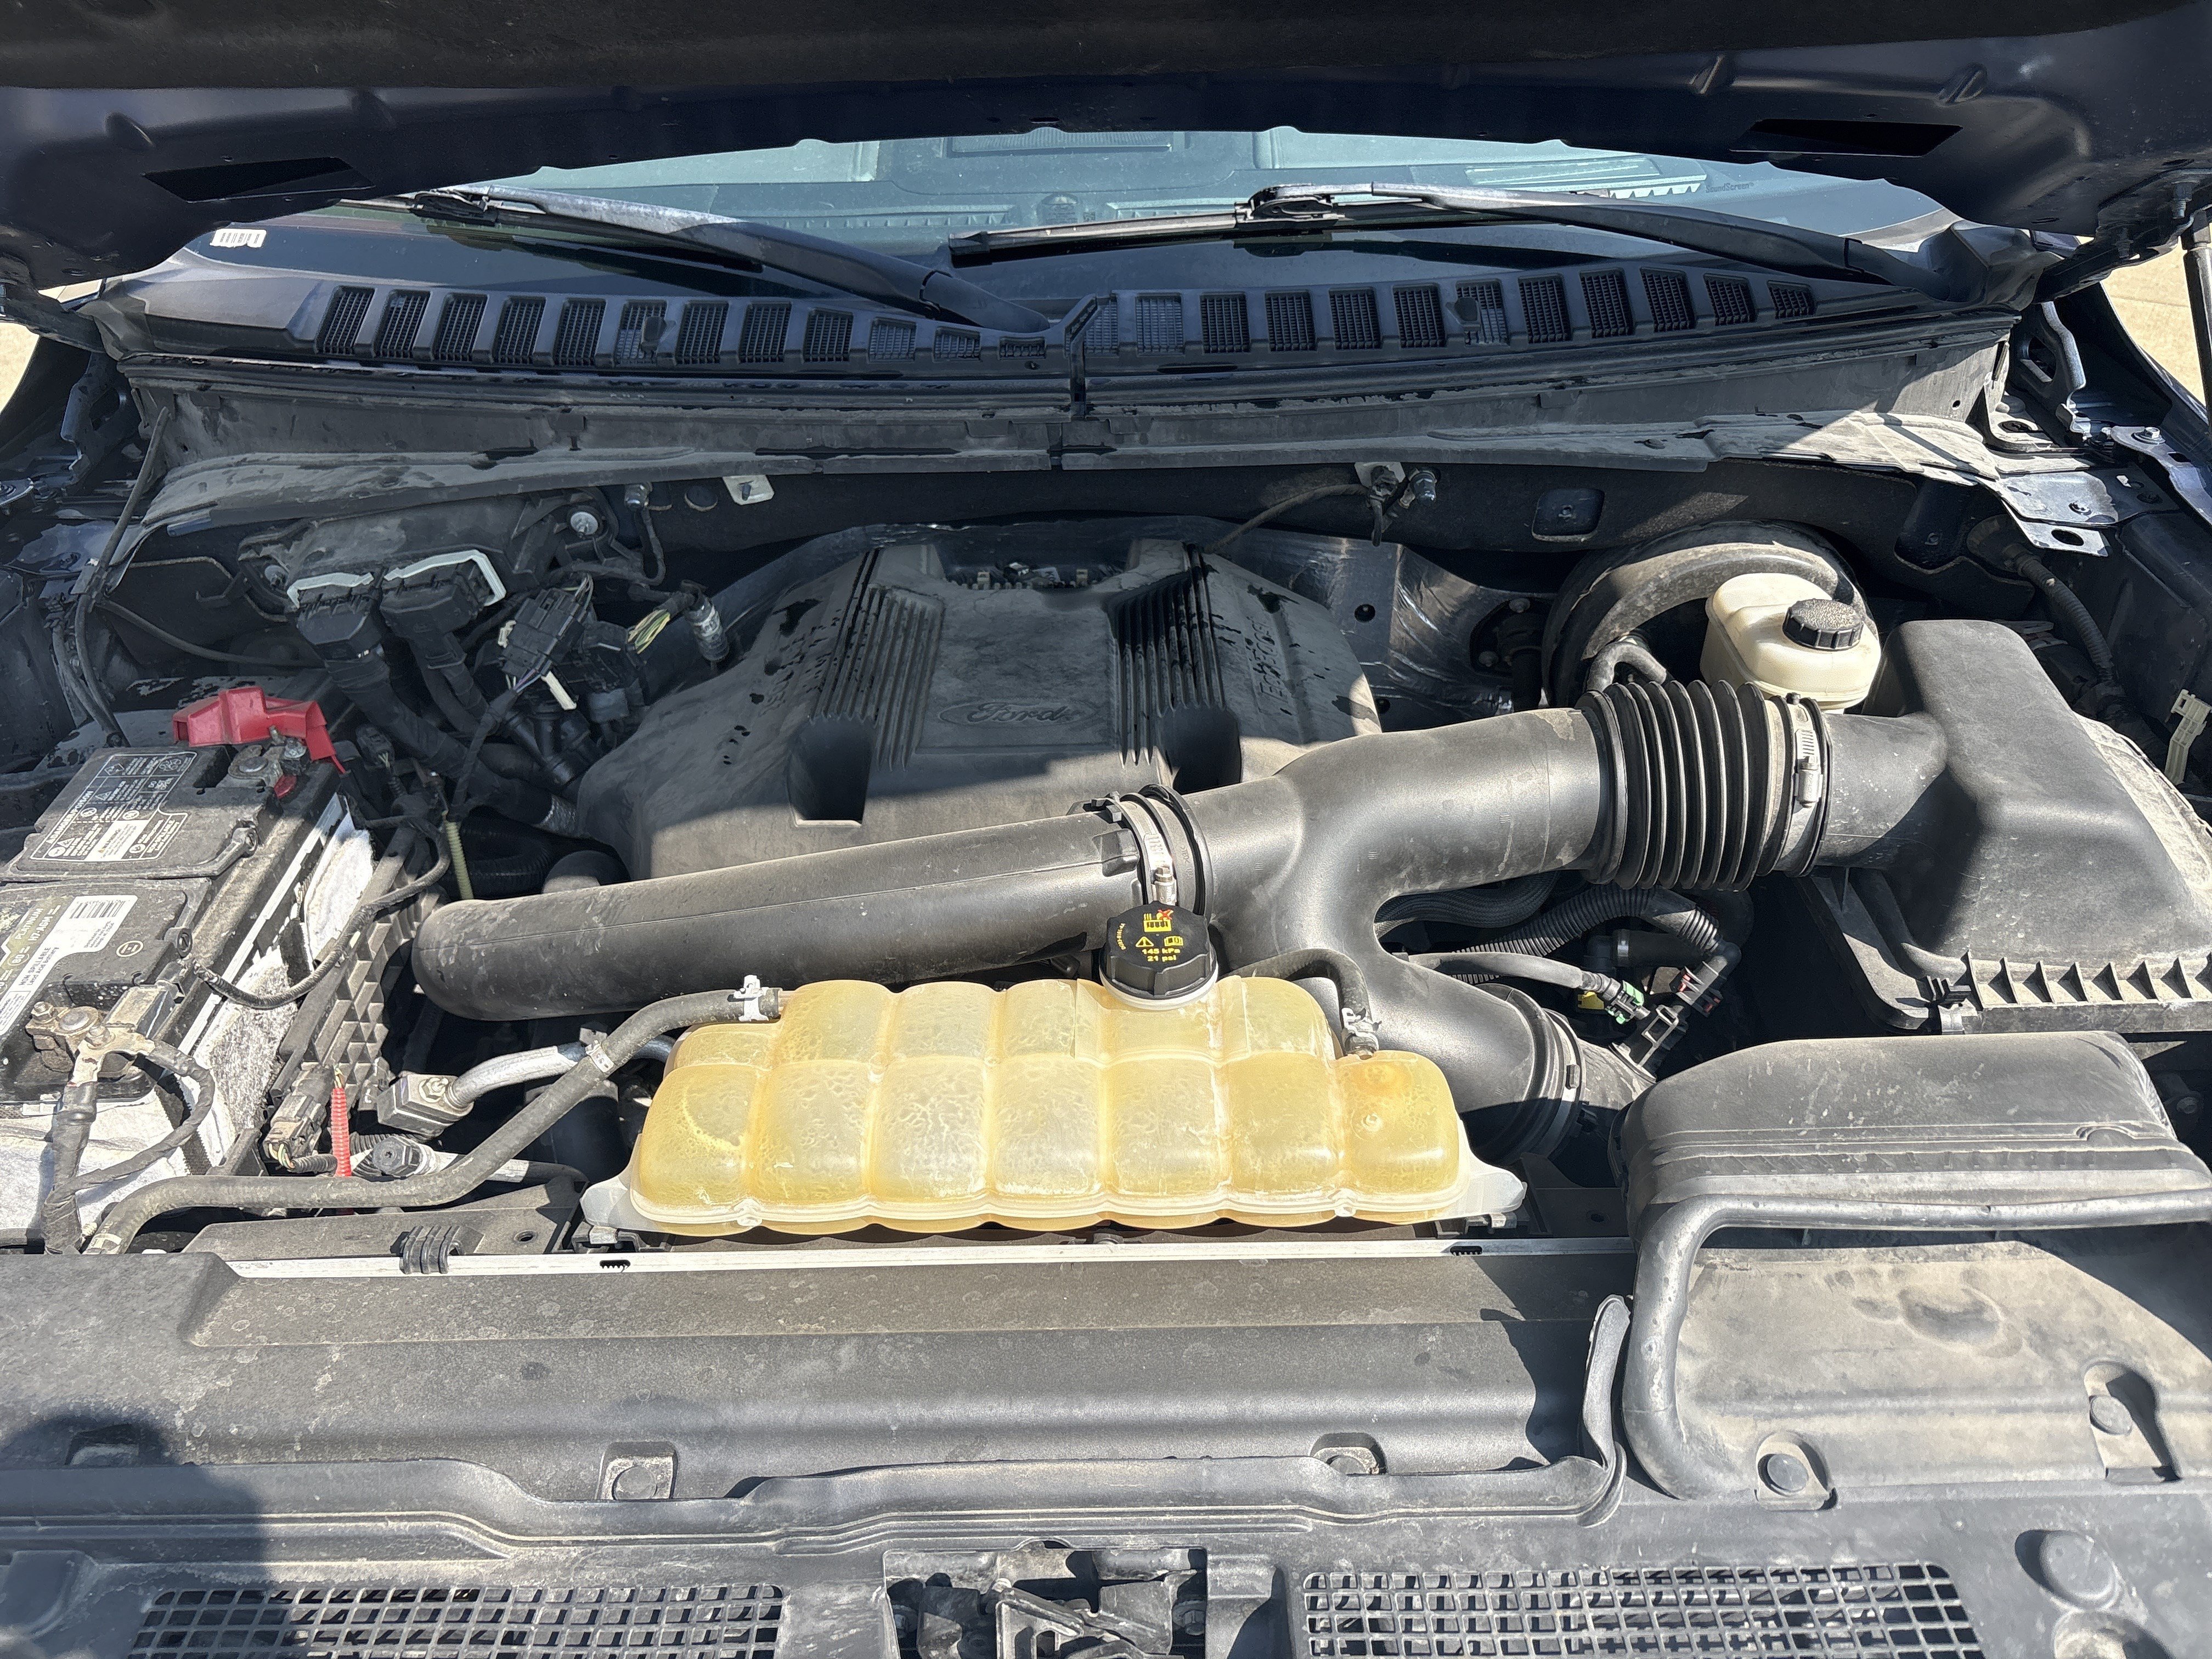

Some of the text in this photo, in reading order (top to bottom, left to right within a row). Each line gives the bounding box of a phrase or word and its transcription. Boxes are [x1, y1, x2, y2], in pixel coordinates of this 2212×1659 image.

[967, 702, 1069, 723] Ford
[49, 791, 94, 840] DANGER/POISON
[14, 908, 43, 940] PLATINUM
[19, 947, 51, 985] NON-SPILLABLE
[43, 947, 60, 963] Battery
